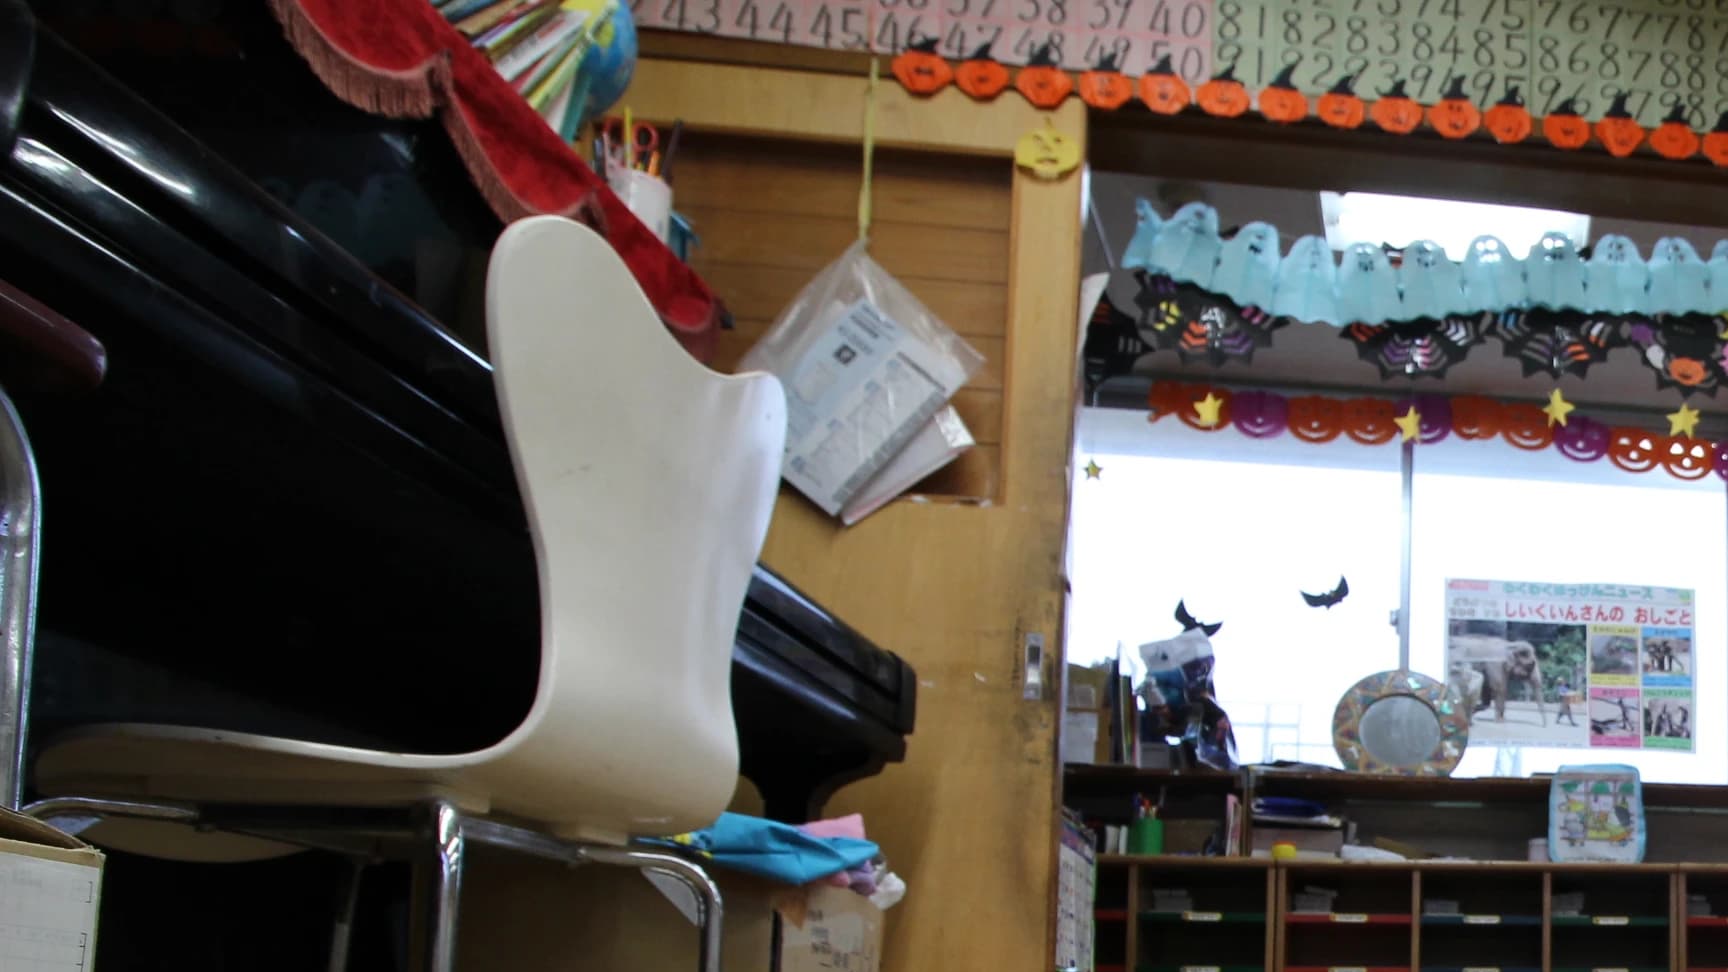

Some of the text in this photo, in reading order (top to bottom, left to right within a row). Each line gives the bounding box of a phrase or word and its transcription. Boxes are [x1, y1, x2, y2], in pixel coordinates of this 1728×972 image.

[661, 0, 721, 32] 43
[735, 0, 795, 44] 44
[809, 4, 866, 48] 45
[1149, 0, 1205, 38] 40
[1538, 0, 1590, 34] 76
[1598, 5, 1653, 42] 77
[1657, 15, 1705, 52] 78
[1217, 0, 1265, 41] 81
[1282, 9, 1336, 50] 82
[1346, 16, 1401, 55] 83
[1411, 22, 1464, 65] 84
[1473, 28, 1527, 70] 85
[1538, 36, 1590, 74] 86
[1598, 42, 1652, 82] 87
[1659, 51, 1706, 91] 88
[1505, 602, 1625, 622] しいくいんさんの
[1633, 606, 1692, 626] おしごと
